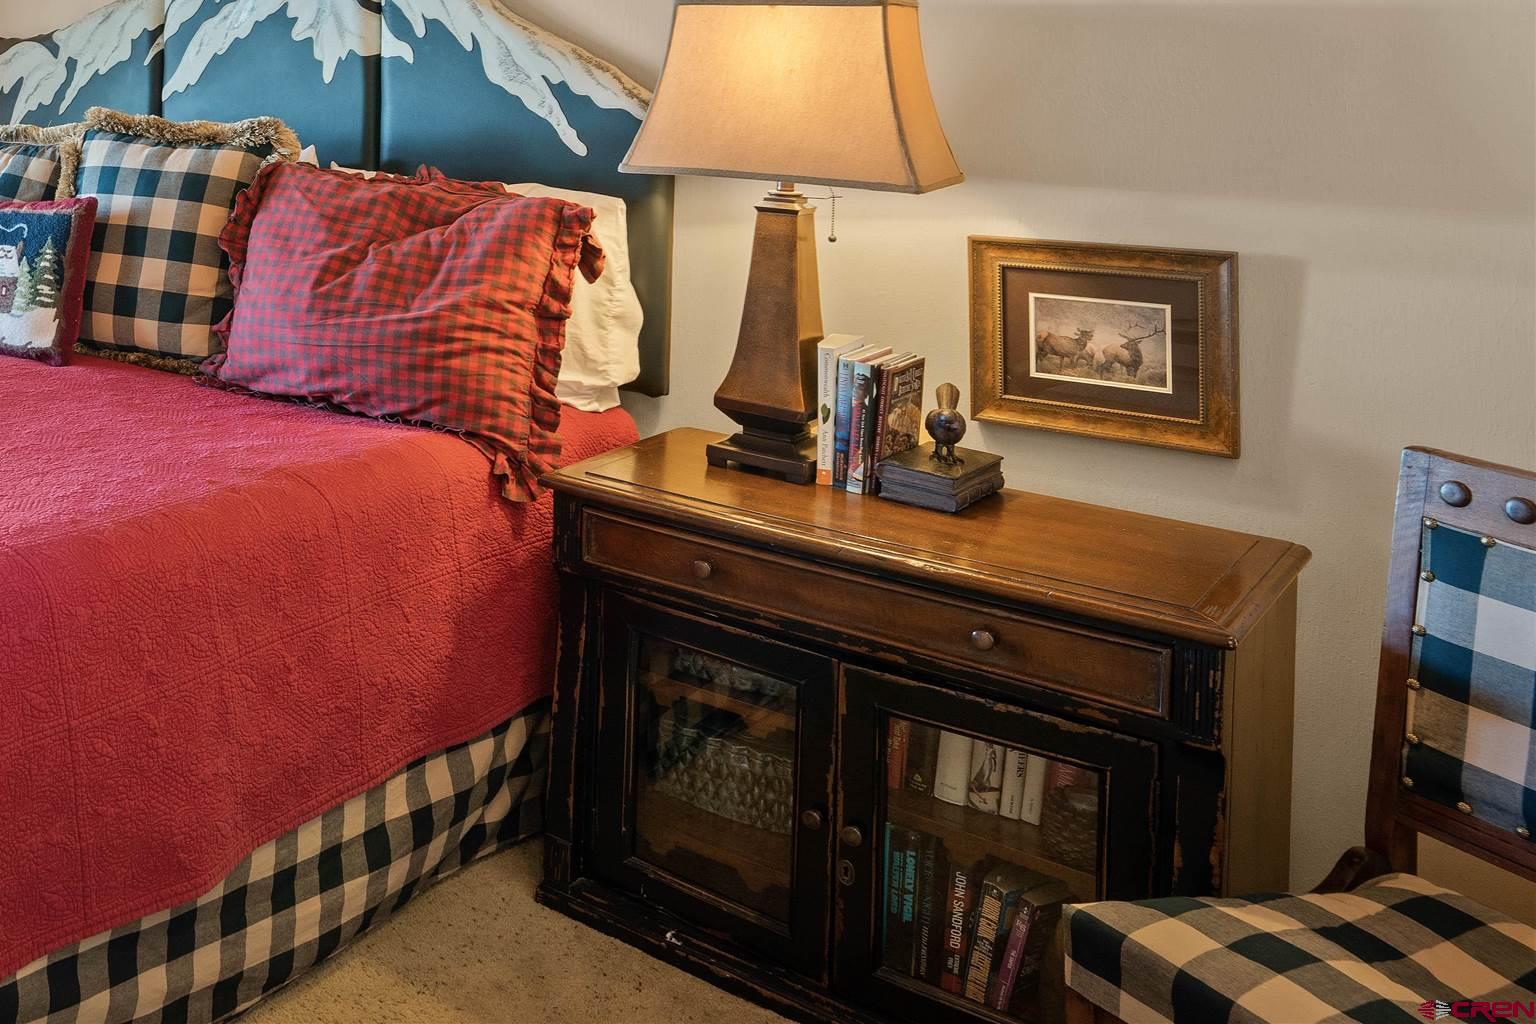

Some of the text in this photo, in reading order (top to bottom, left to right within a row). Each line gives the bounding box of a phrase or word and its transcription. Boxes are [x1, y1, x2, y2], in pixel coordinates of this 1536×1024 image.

[906, 849, 917, 891] LONELY
[949, 871, 967, 949] JOHN SANDFORD
